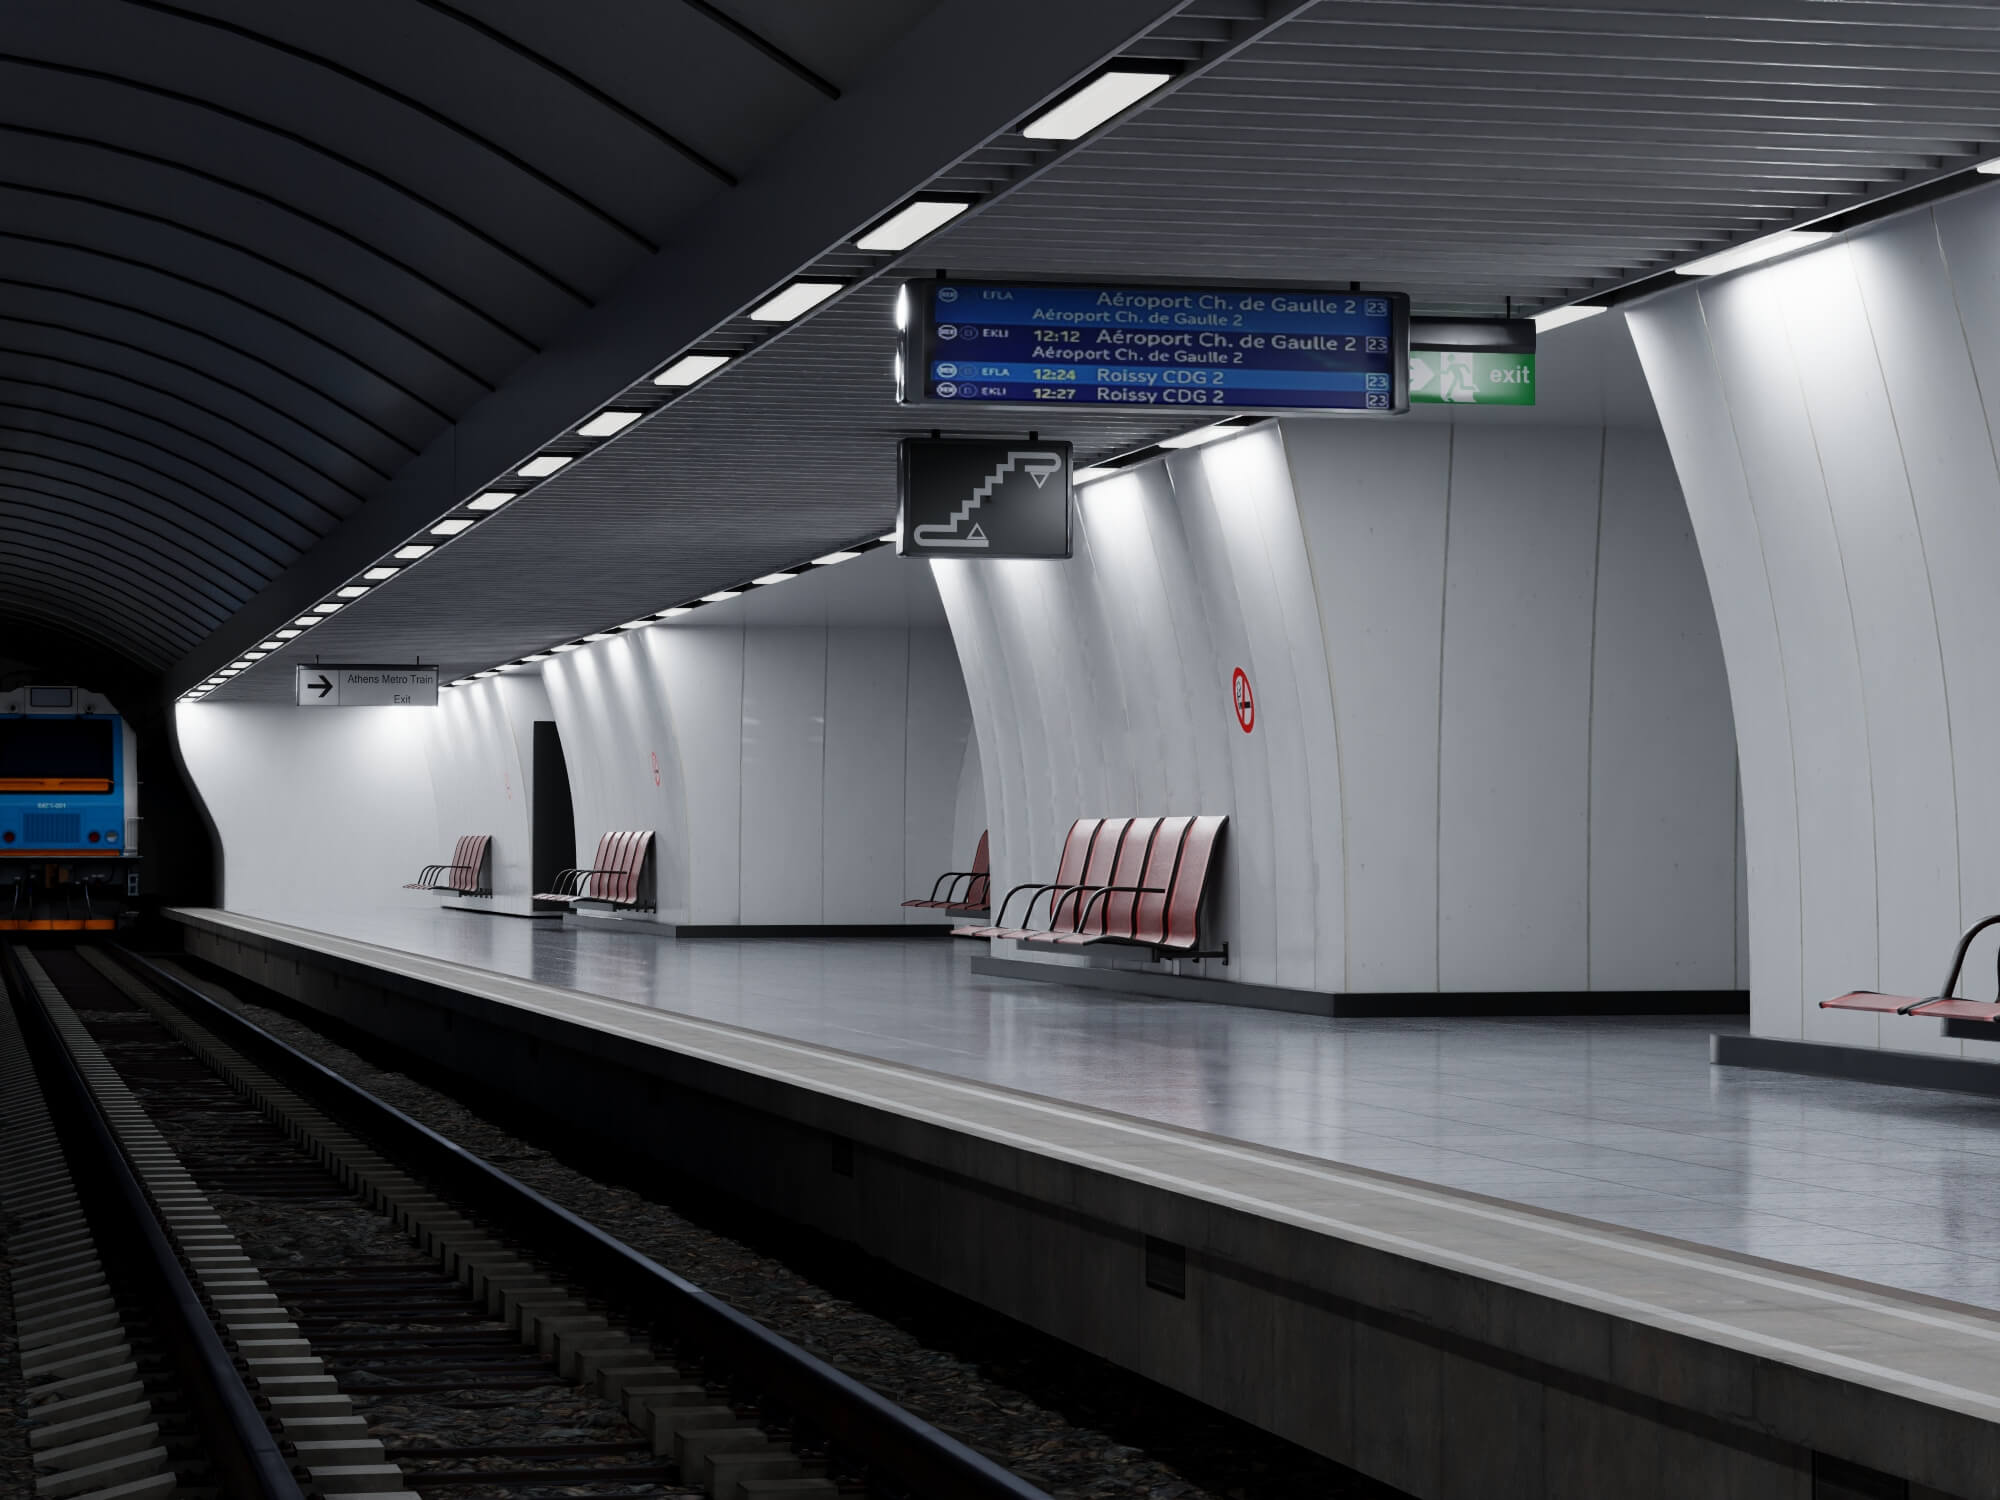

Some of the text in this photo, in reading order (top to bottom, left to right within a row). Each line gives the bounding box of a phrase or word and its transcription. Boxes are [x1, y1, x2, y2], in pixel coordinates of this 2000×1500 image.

[1096, 292, 1193, 310] Aéroport
[1199, 294, 1233, 310] Ch.
[1239, 297, 1265, 312] de
[1271, 297, 1338, 314] Gaulle
[1343, 299, 1357, 315] 2
[1368, 302, 1387, 314] 23
[1032, 308, 1243, 327] Aéroport Ch. de Gaulle 2
[1033, 330, 1081, 343] 12:12
[1096, 329, 1193, 347] Aéroport
[1199, 332, 1233, 348] Ch.
[1239, 334, 1266, 349] de
[1271, 334, 1338, 351] Gaulle
[1344, 336, 1357, 352] 2
[1368, 339, 1388, 351] 23
[1031, 346, 1244, 365] Aéroport Ch. de Gaulle 2
[1033, 368, 1077, 381] 12:24
[1097, 368, 1158, 386] Roissy
[1162, 370, 1207, 385] CDG
[1212, 371, 1224, 385] 2
[1368, 376, 1387, 387] 23
[1489, 364, 1531, 384] exit
[1033, 388, 1077, 400] 12:27
[1097, 387, 1158, 404] Roissy
[1162, 389, 1207, 404] CDG
[1212, 390, 1224, 404] 2
[1368, 394, 1388, 406] 23
[347, 674, 433, 684] Athens Metro Train
[393, 694, 411, 704] Exit
